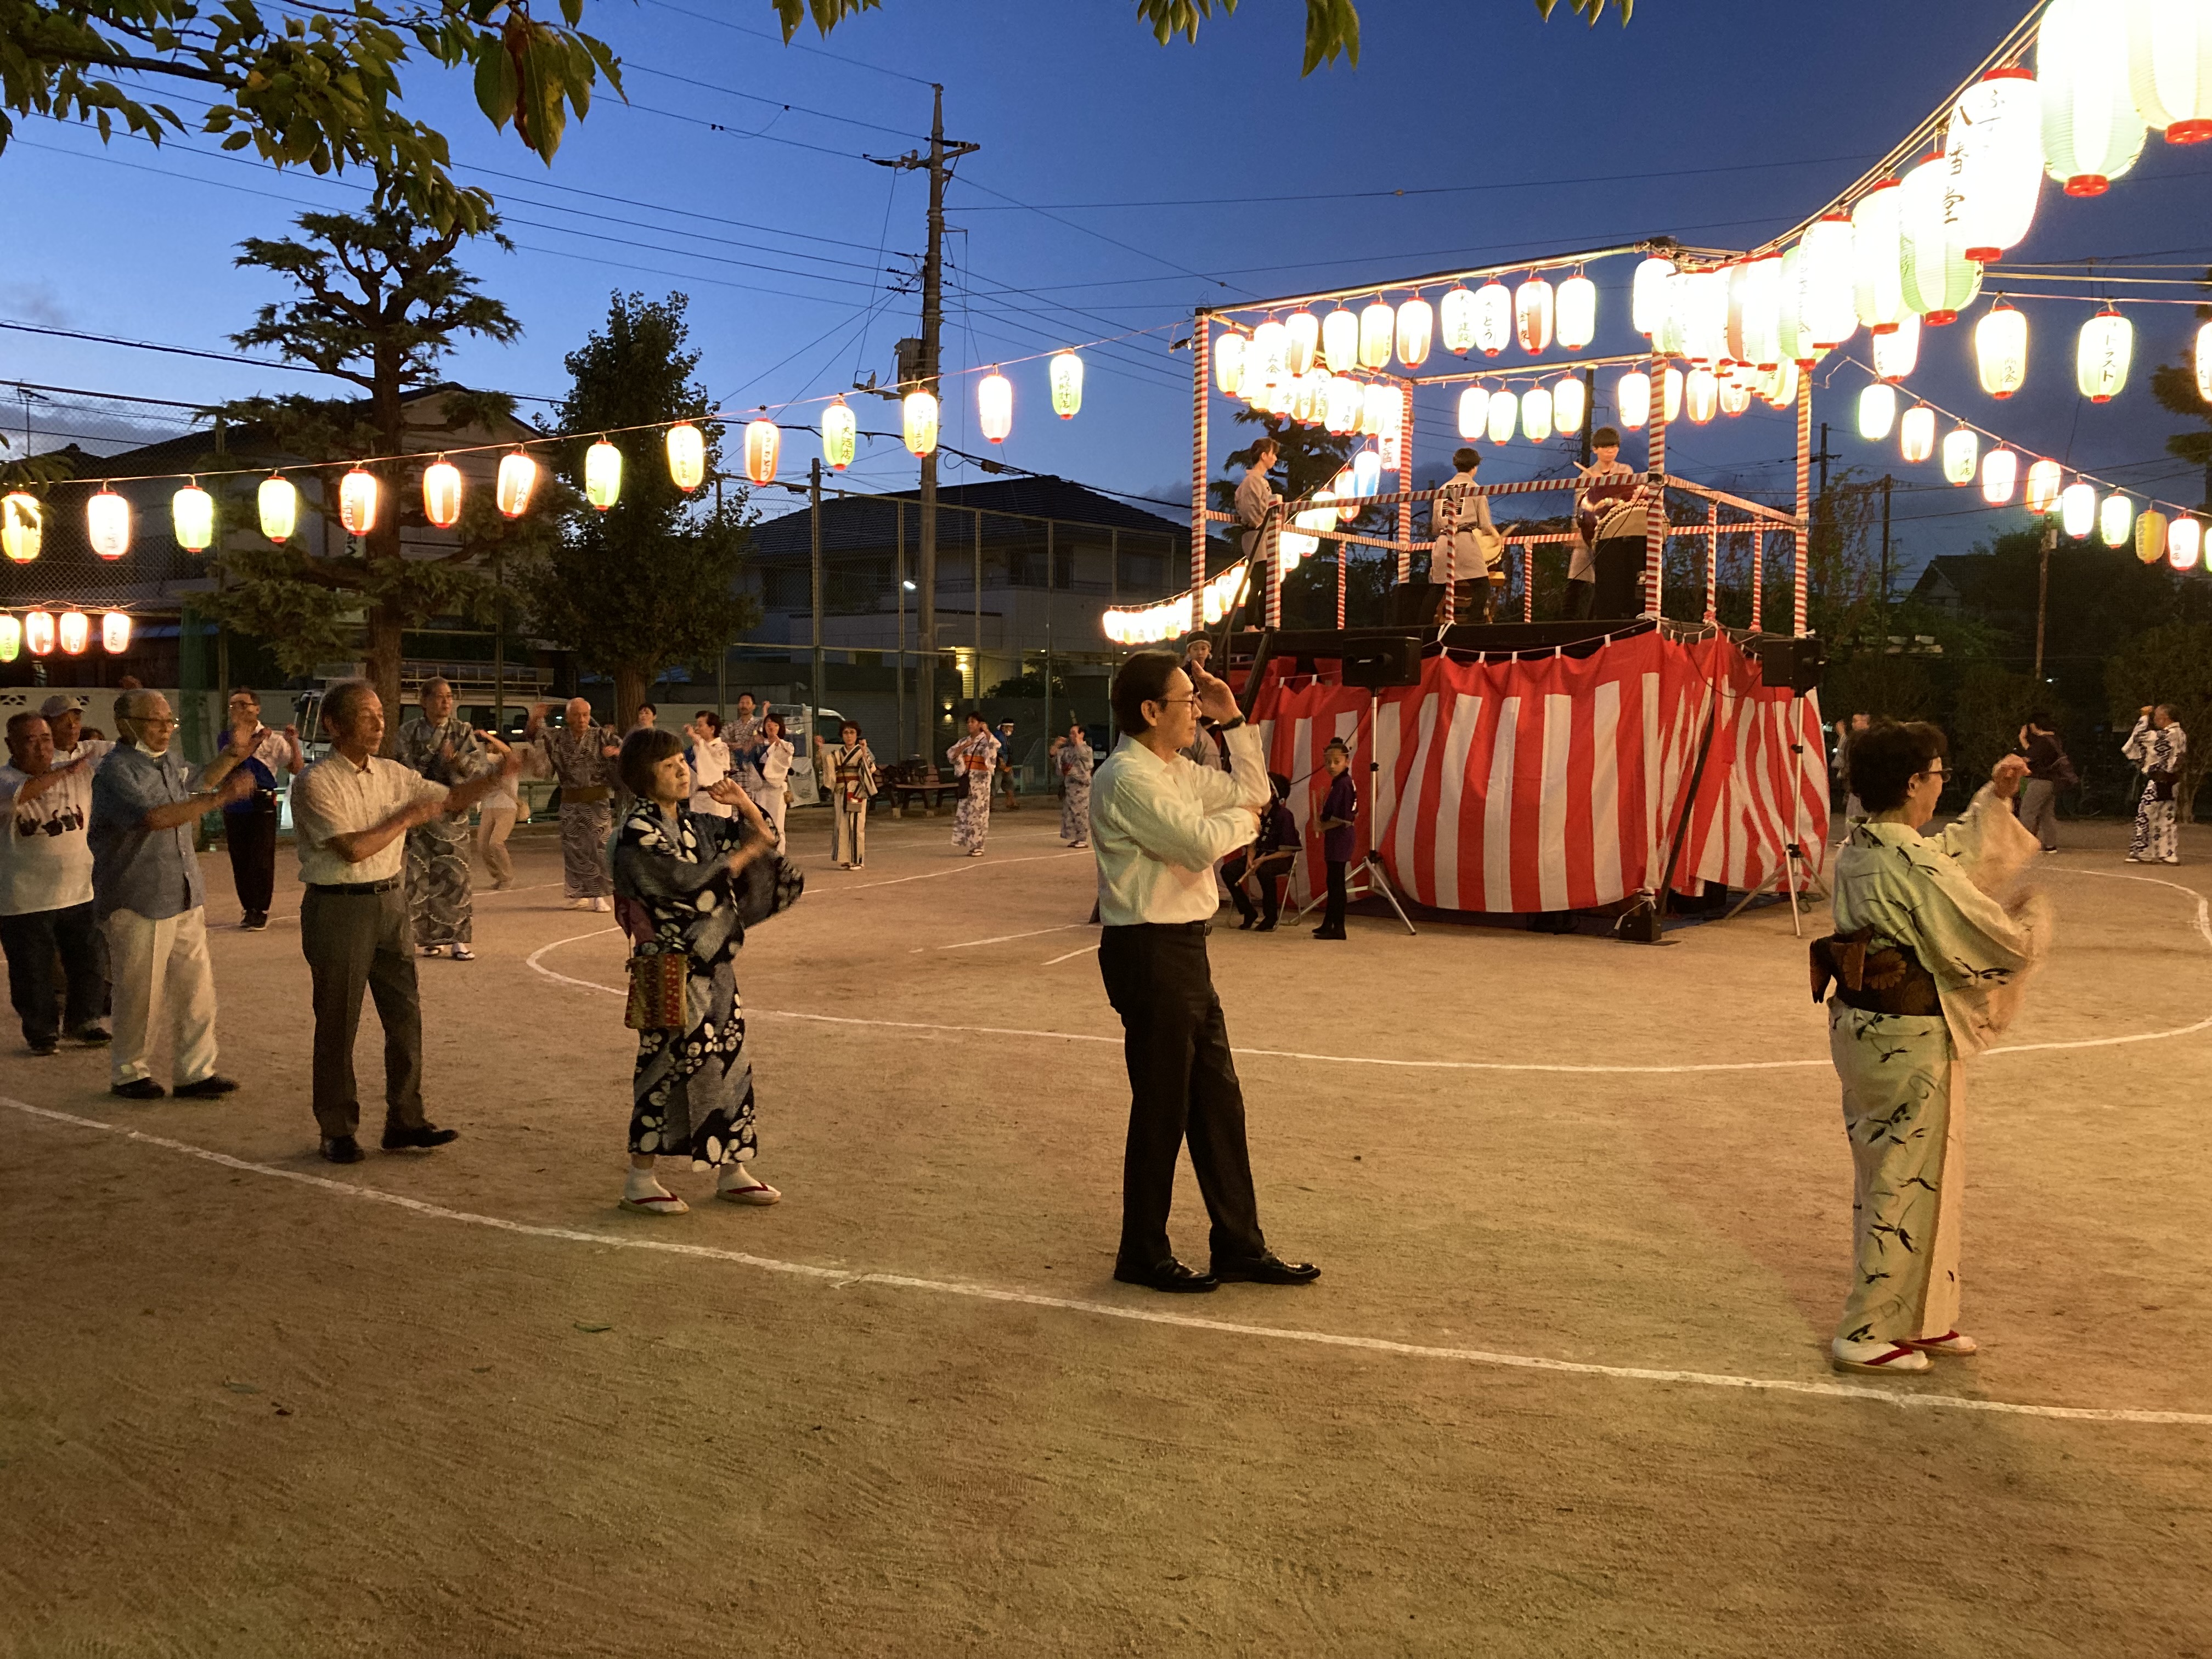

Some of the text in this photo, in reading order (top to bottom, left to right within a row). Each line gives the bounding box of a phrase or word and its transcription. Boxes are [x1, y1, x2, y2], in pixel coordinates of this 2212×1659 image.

[1483, 301, 1493, 340] さとう
[2102, 321, 2117, 382] トラスト
